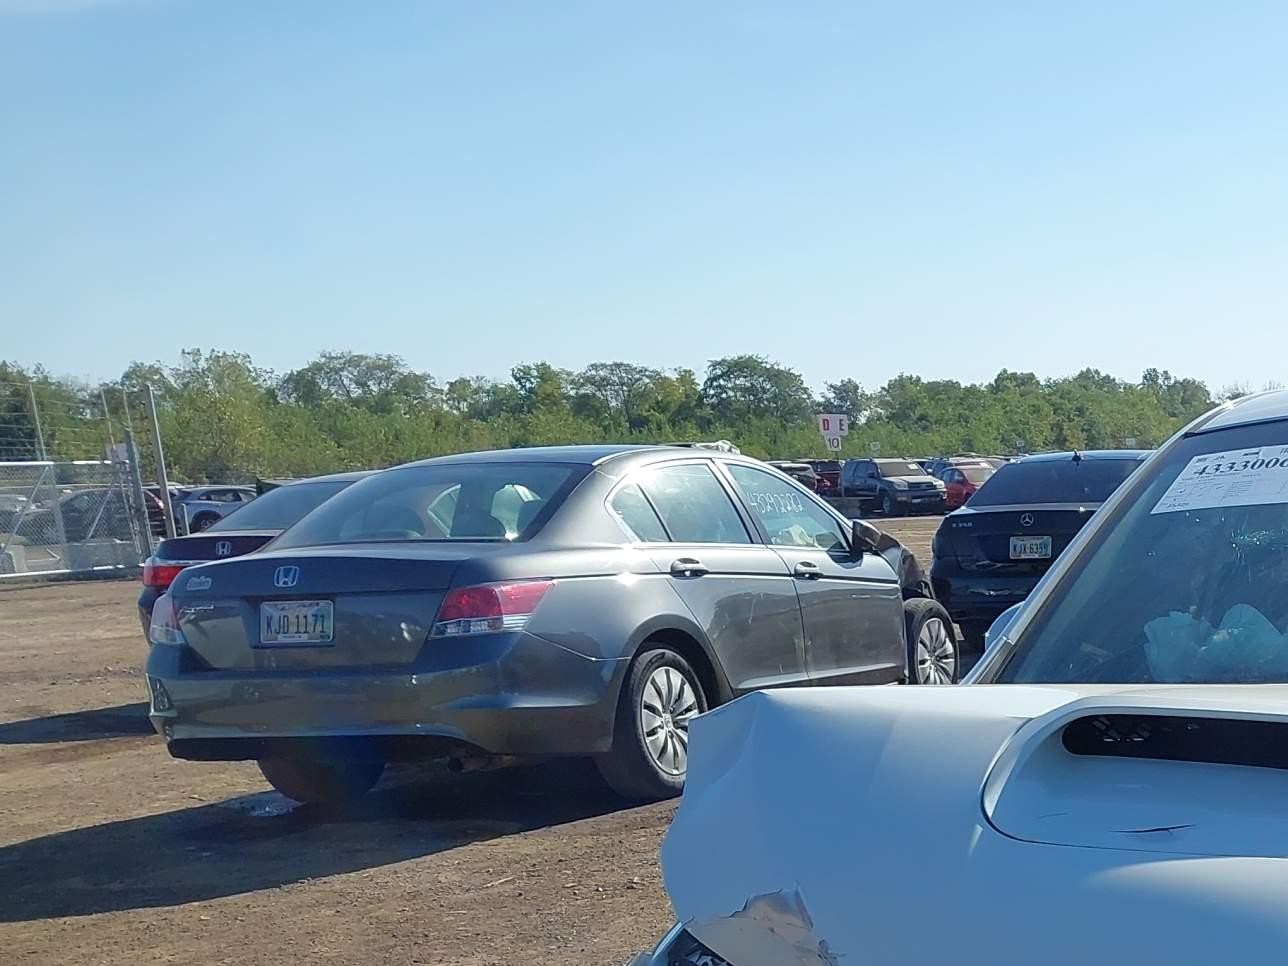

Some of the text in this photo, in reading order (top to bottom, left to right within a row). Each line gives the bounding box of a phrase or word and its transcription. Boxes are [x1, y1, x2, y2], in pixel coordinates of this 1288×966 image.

[839, 418, 845, 431] E
[828, 437, 840, 449] 10
[294, 613, 327, 634] 1171
